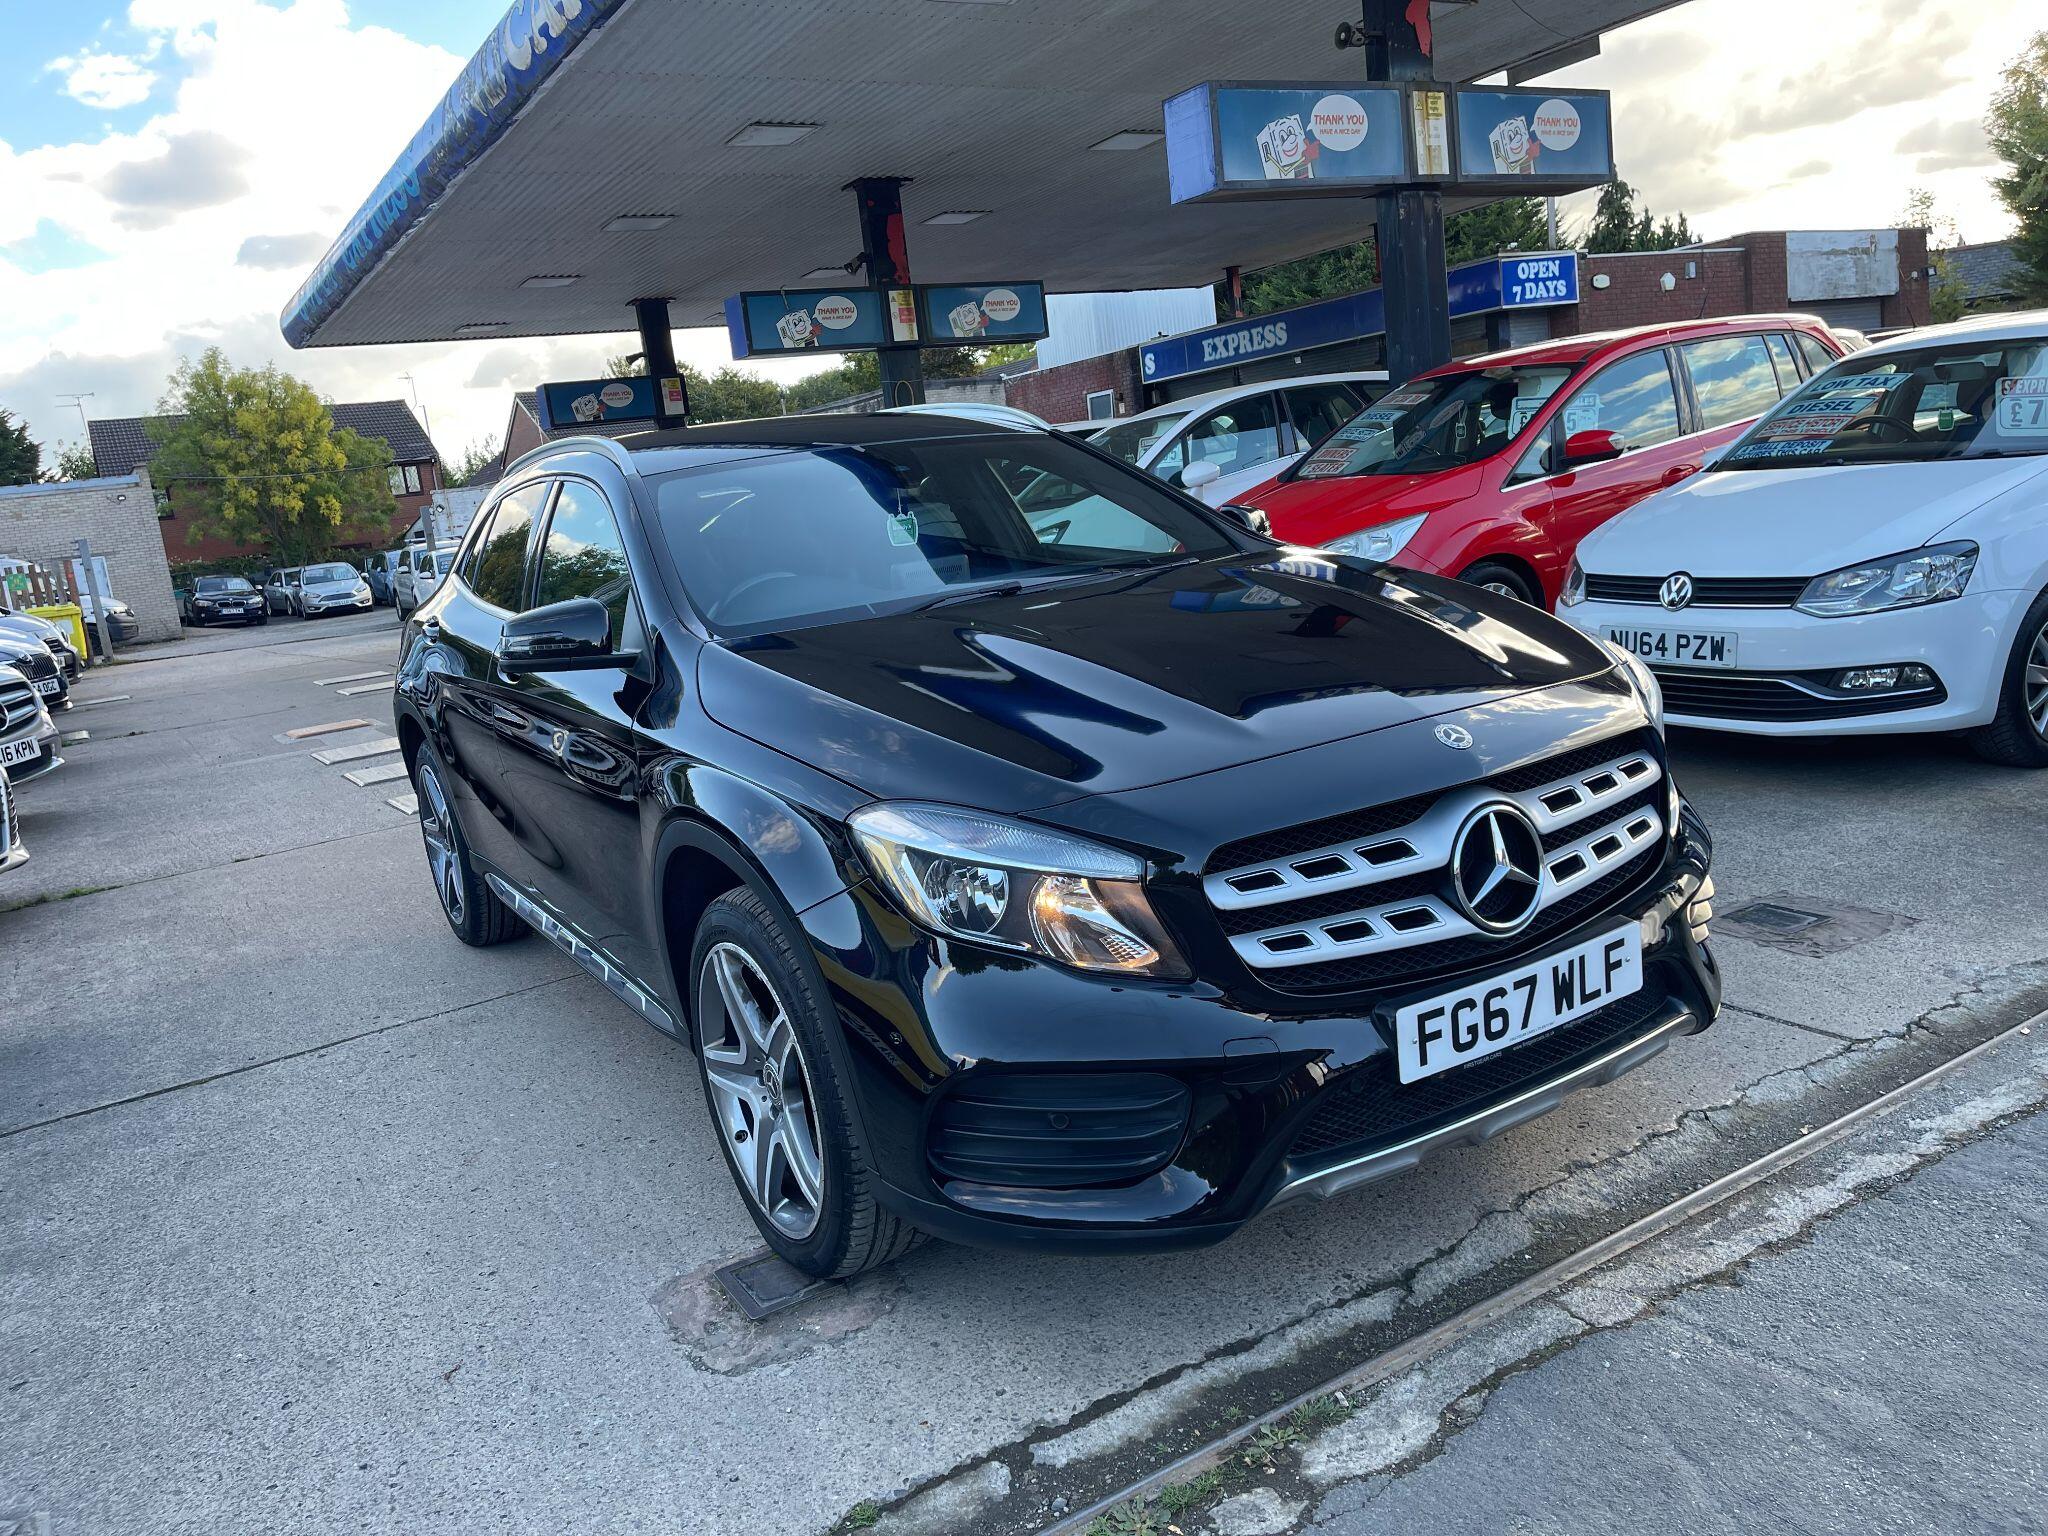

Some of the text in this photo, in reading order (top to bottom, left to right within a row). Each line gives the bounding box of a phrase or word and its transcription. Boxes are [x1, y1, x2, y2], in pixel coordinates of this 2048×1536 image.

[1314, 114, 1365, 125] THANK YOU
[1537, 116, 1578, 128] THANK YOU
[1518, 260, 1560, 280] OPEN
[1512, 280, 1567, 303] 7 DAYS
[818, 306, 855, 315] THANK YOU
[1144, 321, 1288, 375] S EXPRESS
[1811, 376, 1898, 392] LOW TAX
[2015, 379, 2048, 394] EXPR
[1787, 401, 1856, 414] DIESEL
[1780, 440, 1829, 450] DEPOSIT
[1611, 630, 1726, 661] NU64 PZW
[14, 739, 36, 759] KPN
[1417, 938, 1625, 1067] FG67 WLF
